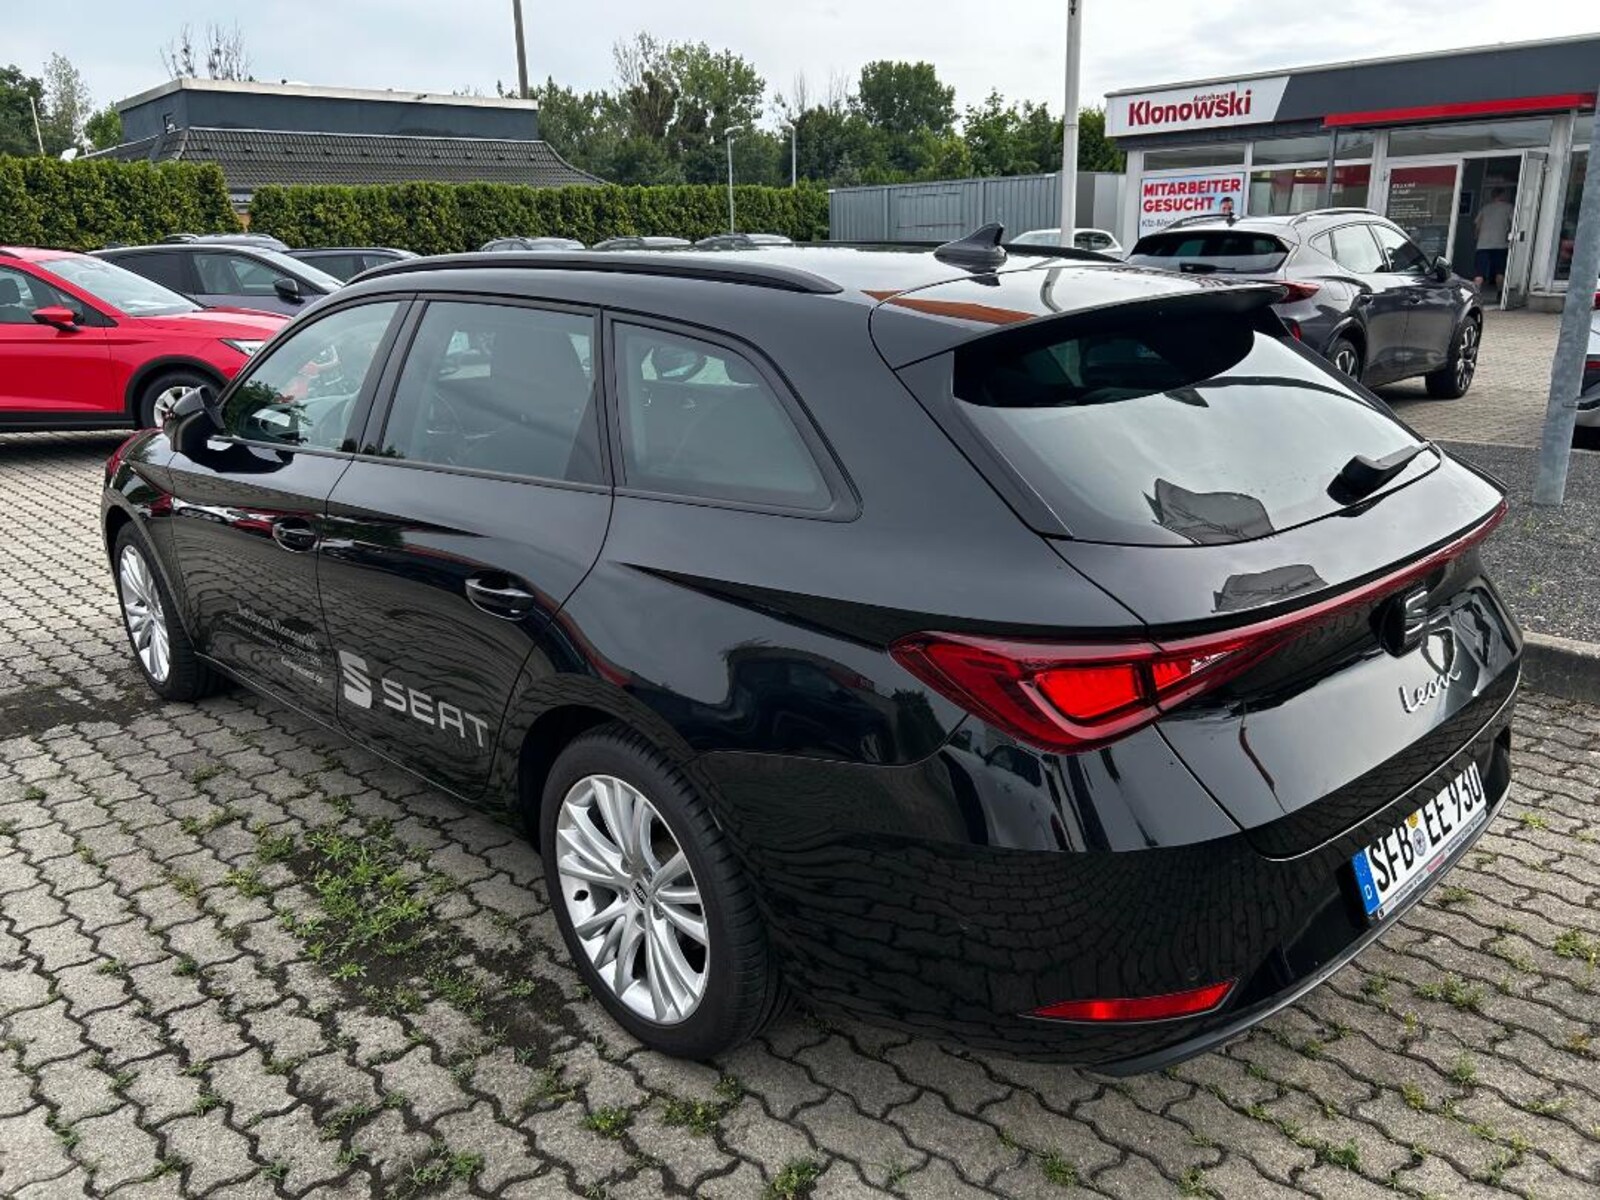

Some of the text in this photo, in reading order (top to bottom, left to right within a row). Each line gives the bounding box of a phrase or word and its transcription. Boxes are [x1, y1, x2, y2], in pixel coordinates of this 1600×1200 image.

[1128, 89, 1252, 126] Klonowski
[1143, 178, 1241, 197] MITARBEITER
[1143, 197, 1215, 213] GESUCHT
[381, 678, 489, 747] SEAT
[1398, 669, 1462, 714] Leon
[1448, 762, 1483, 823] 930
[1421, 797, 1453, 848] EE
[1368, 826, 1415, 892] SFB
[1364, 885, 1373, 900] D
